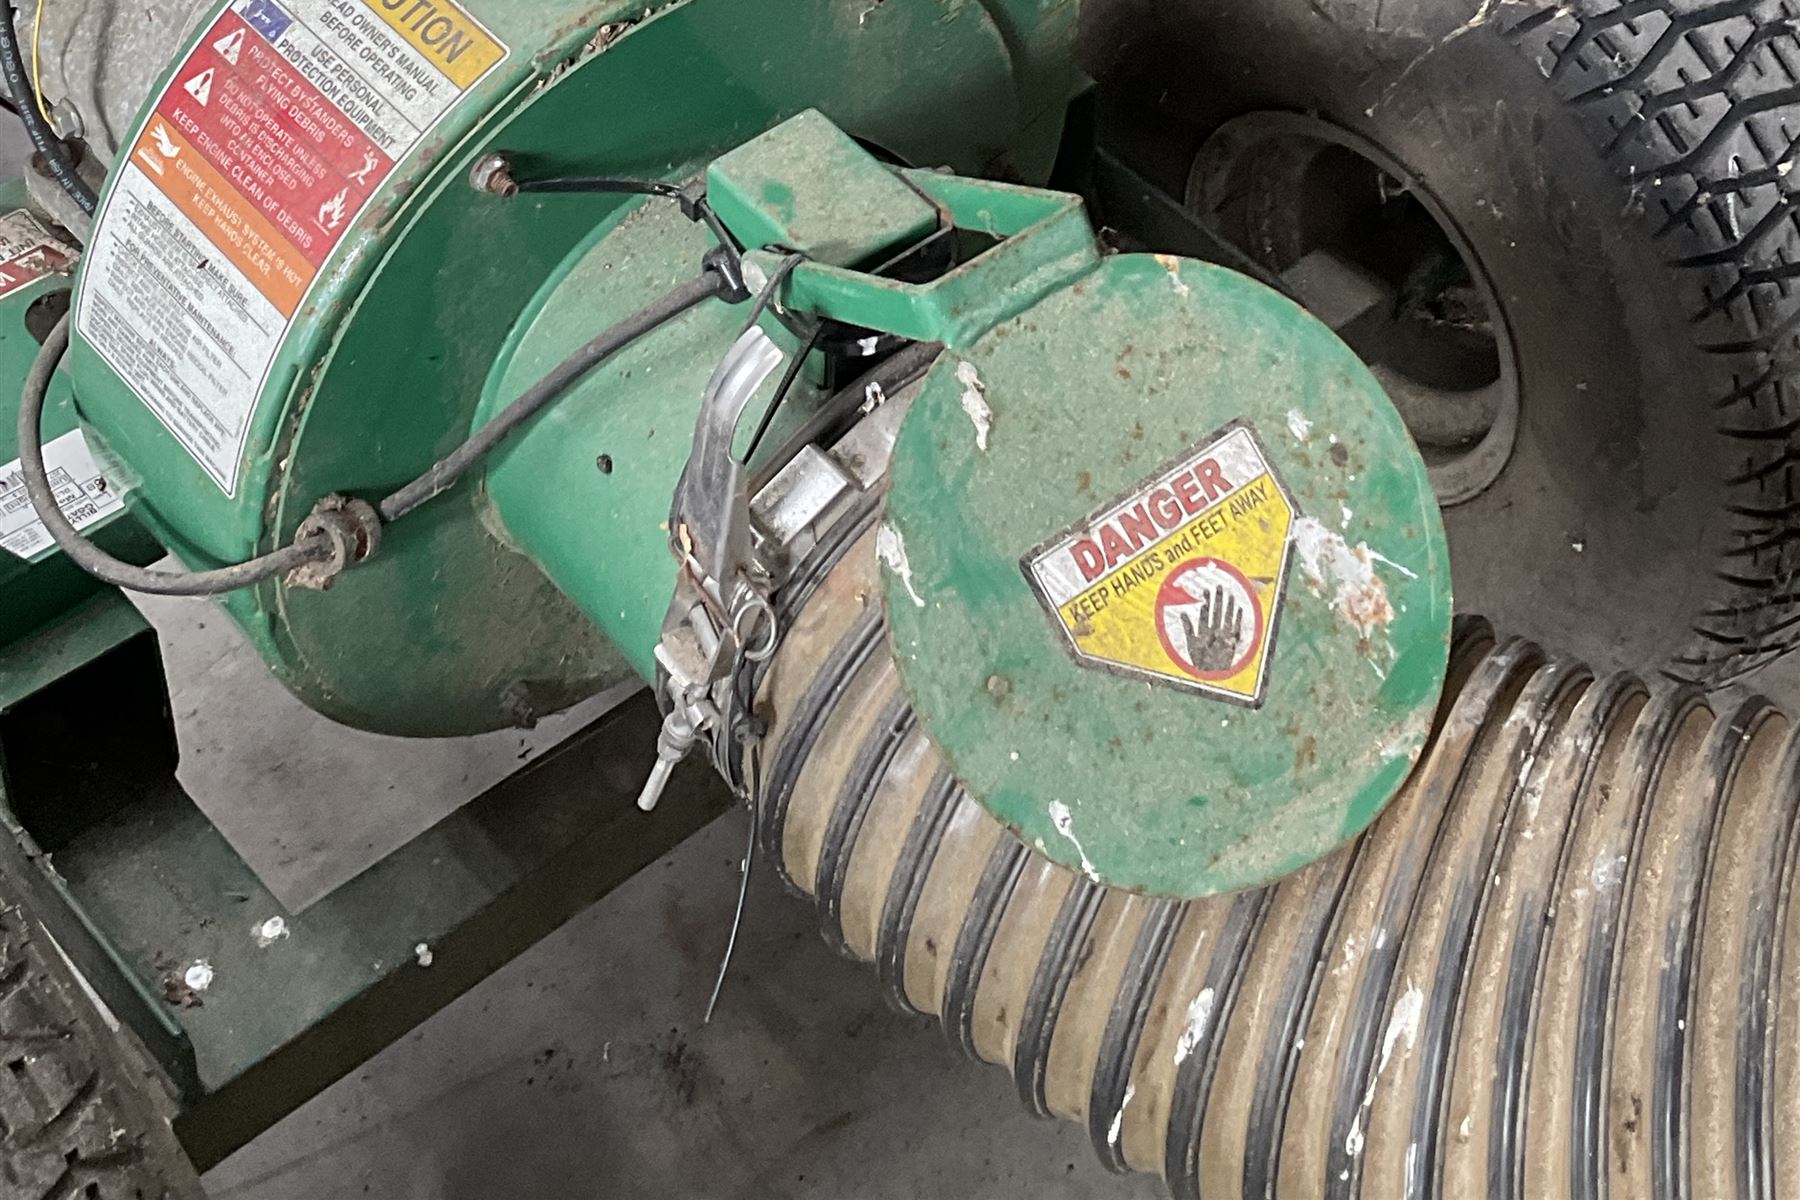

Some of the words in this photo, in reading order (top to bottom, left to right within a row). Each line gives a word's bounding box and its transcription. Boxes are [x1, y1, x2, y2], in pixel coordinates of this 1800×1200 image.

[247, 44, 294, 91] PROTECT
[289, 84, 355, 149] BYSTANDERS
[276, 38, 341, 99] PROTECTION
[336, 92, 395, 151] EQUIPMENT
[309, 43, 335, 70] USE
[329, 61, 386, 117] PERSONAL
[318, 10, 363, 51] BEFORE
[357, 45, 418, 101] OPERATING
[350, 12, 400, 59] OWNER'S
[394, 53, 441, 96] MANUAL
[252, 107, 294, 149] OPERATE
[290, 142, 328, 180] UNLESS
[254, 73, 291, 110] FLYING
[287, 104, 326, 144] DEBRIS
[171, 107, 200, 137] KEEP
[195, 130, 234, 170] ENGINE
[229, 163, 266, 201] CLEAN
[262, 195, 279, 214] OF
[274, 208, 314, 249] DEBRIS
[175, 157, 206, 193] ENGINE
[191, 192, 215, 220] KEEP
[147, 200, 173, 231] BEFORE
[207, 263, 227, 286] MAKE
[1069, 458, 1233, 583] DANGER
[1069, 588, 1110, 624] KEEP
[1112, 552, 1165, 598] HANDS
[1166, 533, 1193, 564] and
[1189, 509, 1228, 552] FEET
[1228, 482, 1268, 519] AWAY
